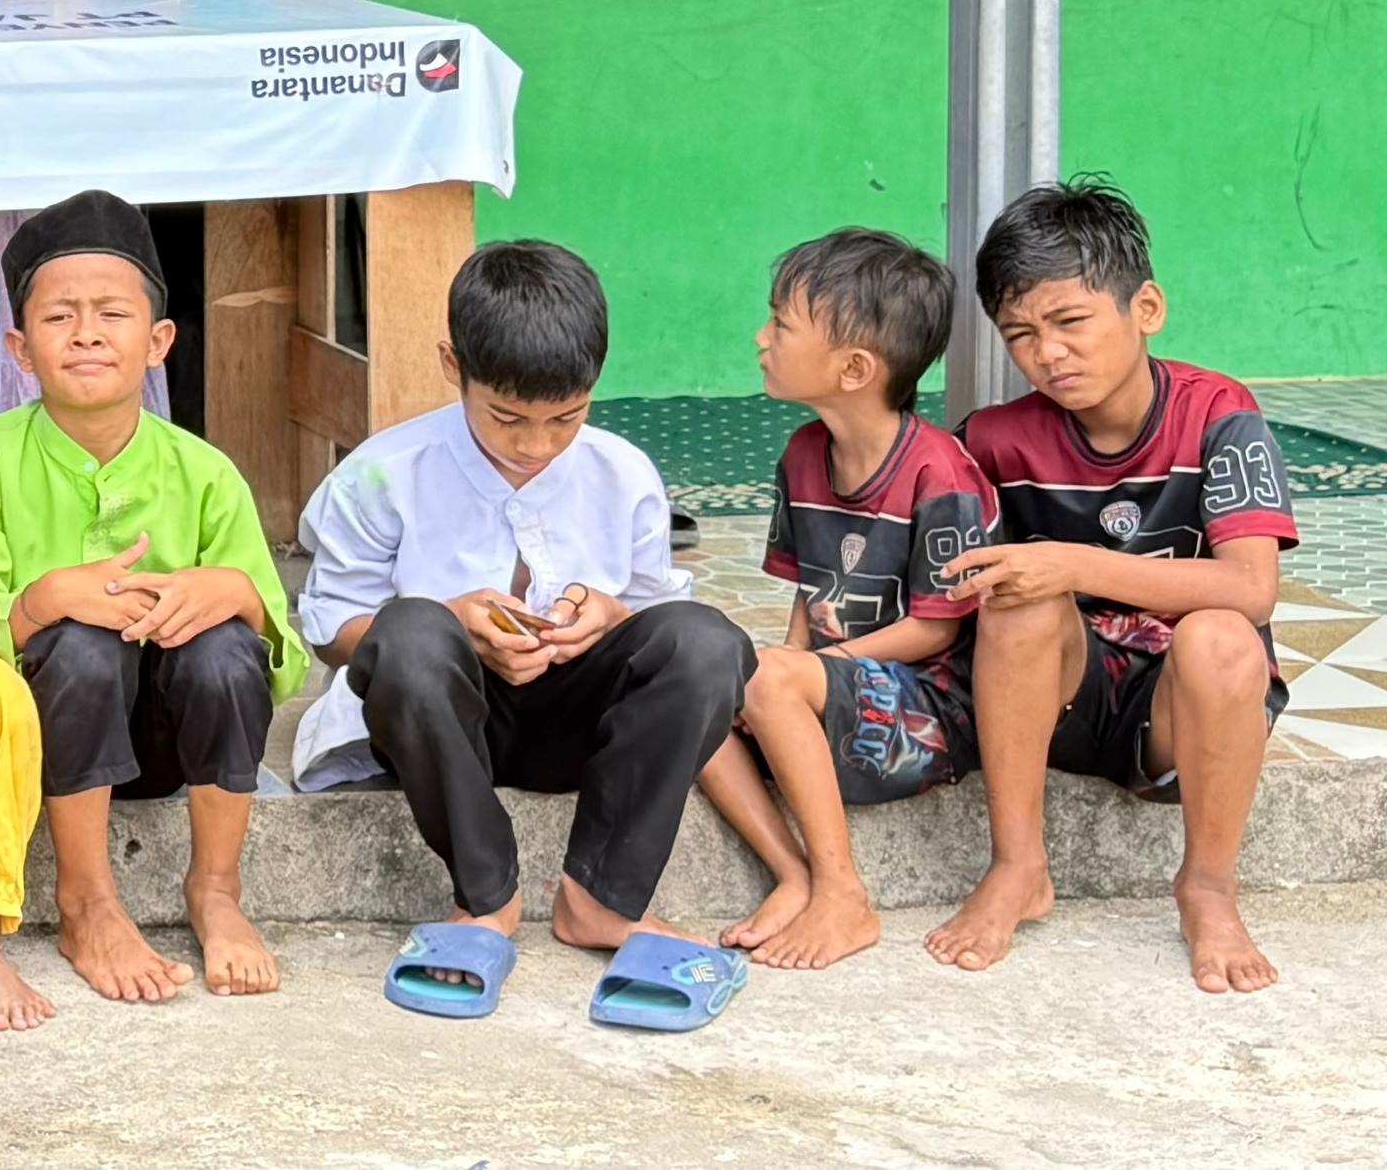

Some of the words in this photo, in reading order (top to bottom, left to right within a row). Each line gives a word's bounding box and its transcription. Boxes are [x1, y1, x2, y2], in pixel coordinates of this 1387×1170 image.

[260, 40, 406, 73] Indonesia
[251, 72, 407, 101] Danantara
[1203, 441, 1282, 514] 93
